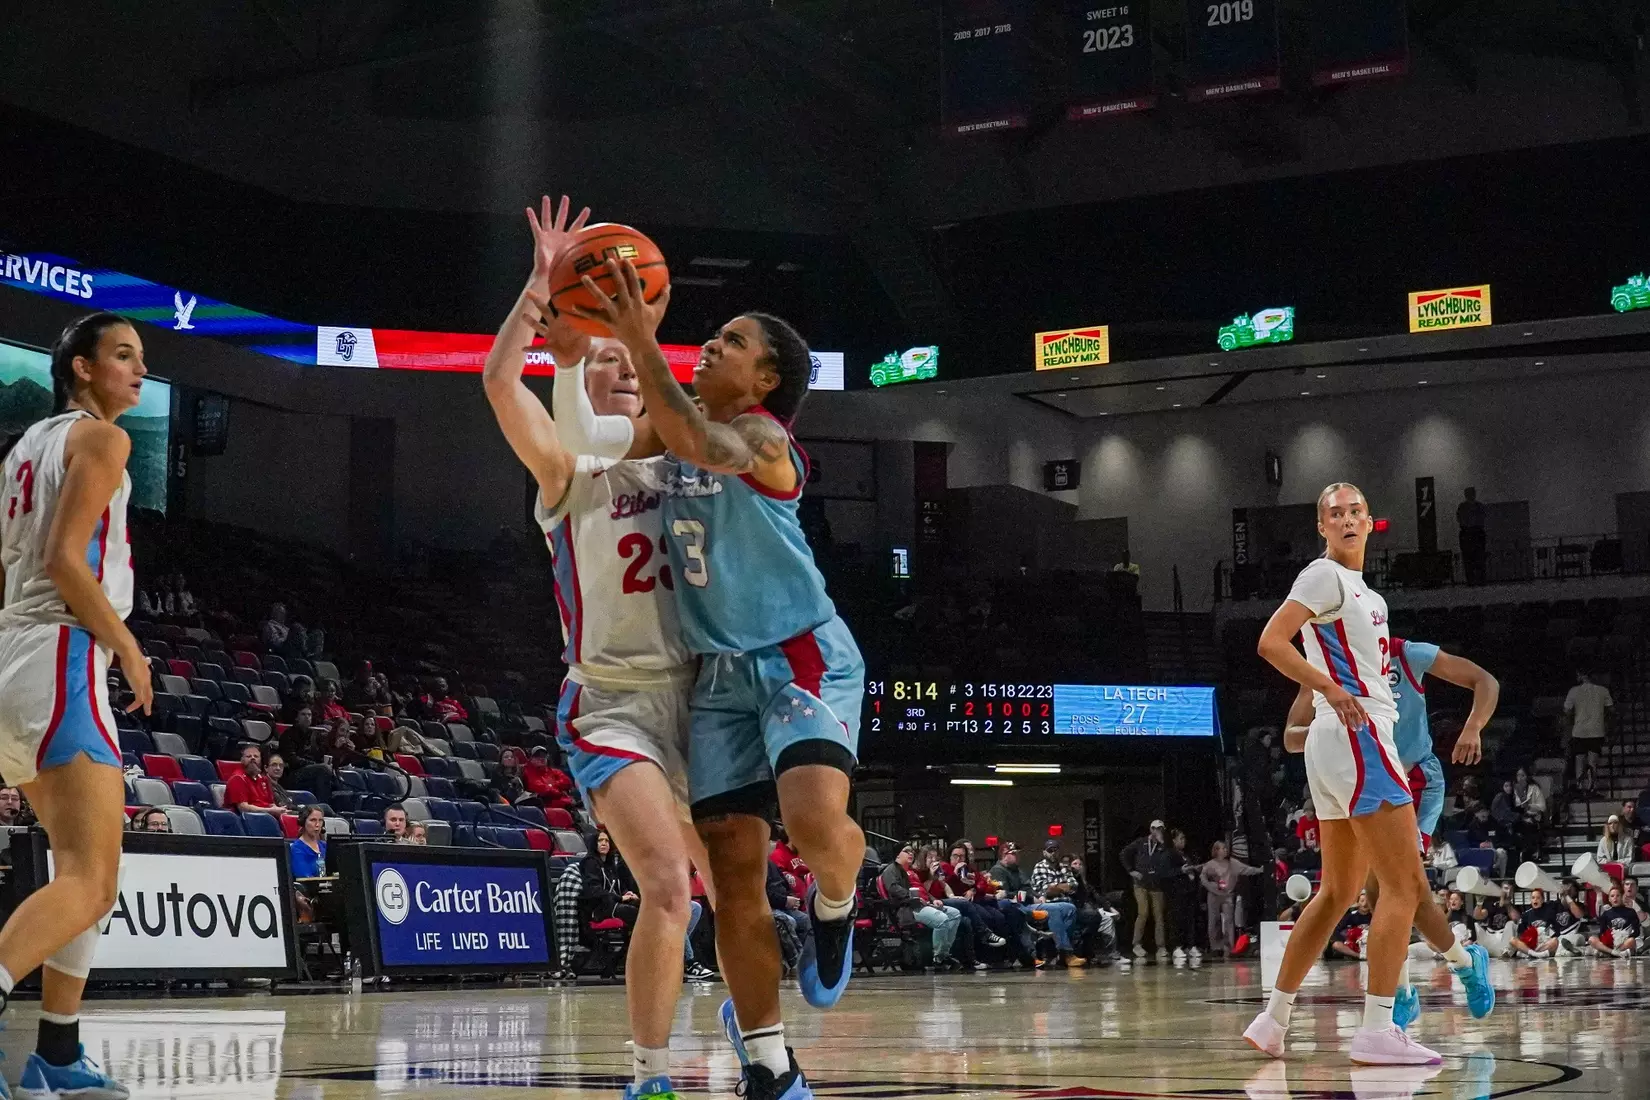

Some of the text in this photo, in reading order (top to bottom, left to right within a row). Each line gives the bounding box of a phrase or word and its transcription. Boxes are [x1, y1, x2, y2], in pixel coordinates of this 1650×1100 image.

[1087, 5, 1129, 21] SWEET 16
[1207, 0, 1254, 27] 2019
[974, 26, 991, 38] 2017
[994, 23, 1012, 35] 2018
[1082, 23, 1135, 54] 2023
[1331, 64, 1390, 80] MEN'S BASKETBALL
[1205, 80, 1262, 96] MEN'S BASKETBALL
[1102, 100, 1138, 114] BASKETBALL
[957, 118, 1009, 133] MEN'S BASKETBALL
[0, 252, 93, 299] RVICES
[1417, 297, 1481, 318] LYNCHBURG
[1418, 313, 1482, 329] READY MIX
[1043, 337, 1100, 357] LYNCHBURG
[1043, 352, 1100, 367] READY MIX
[1234, 521, 1248, 565] OMEN
[672, 518, 709, 589] 3
[868, 681, 884, 695] 31
[893, 681, 938, 700] 8:14
[949, 683, 1053, 698] # 3 15 18 22 23
[1104, 688, 1167, 701] LA TECH
[873, 700, 880, 714] 1
[906, 708, 926, 717] 3RD
[949, 701, 1050, 717] F 2 1 0 0 2
[1123, 704, 1150, 725] 27
[871, 717, 881, 732] 2
[906, 722, 917, 731] 30
[946, 719, 1050, 735] PT 13 2 2 5 3
[1071, 714, 1100, 725] POSS
[1085, 816, 1099, 854] MEN
[415, 880, 483, 914] Carter
[486, 880, 543, 914] Bank
[101, 882, 279, 939] Autova
[415, 932, 530, 951] LIFE LIVED FULL
